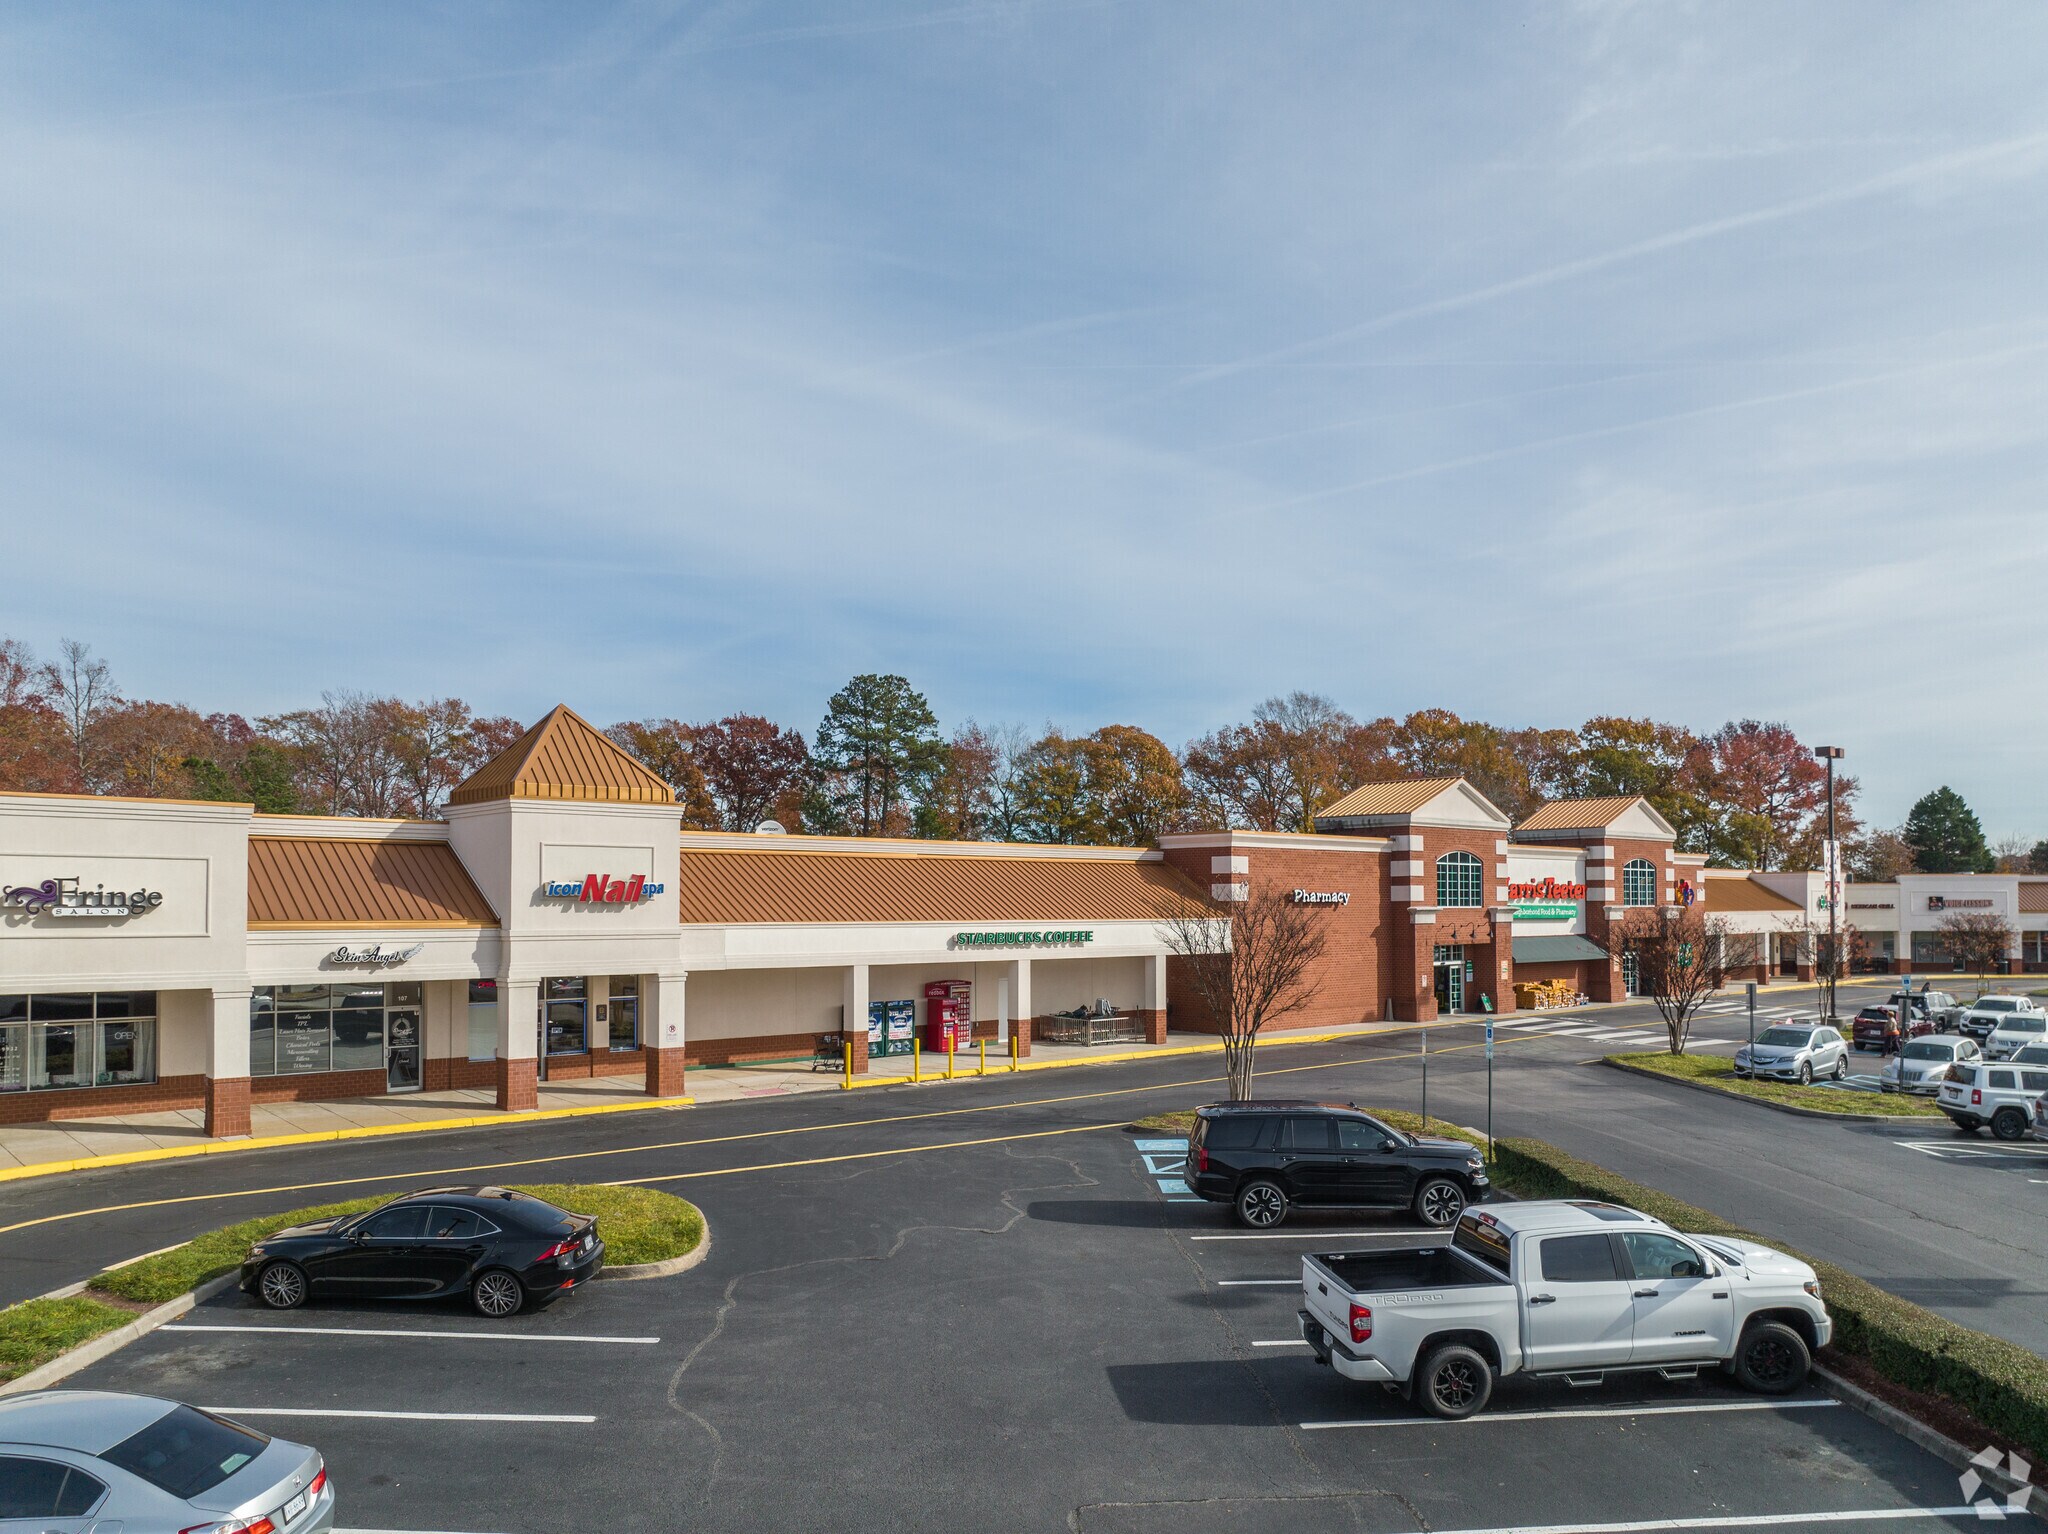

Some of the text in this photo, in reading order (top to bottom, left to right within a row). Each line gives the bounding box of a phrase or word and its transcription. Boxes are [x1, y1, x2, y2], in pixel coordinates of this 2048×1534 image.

[53, 876, 163, 915] Fringe
[548, 873, 664, 902] icon Nail spa
[1506, 877, 1545, 899] arris
[1294, 889, 1350, 906] Pharmacy
[55, 908, 126, 916] SALON
[956, 930, 1094, 945] STARBUCKS COFFEE
[334, 945, 399, 966] Skin Angel
[114, 1031, 138, 1040] OPEN
